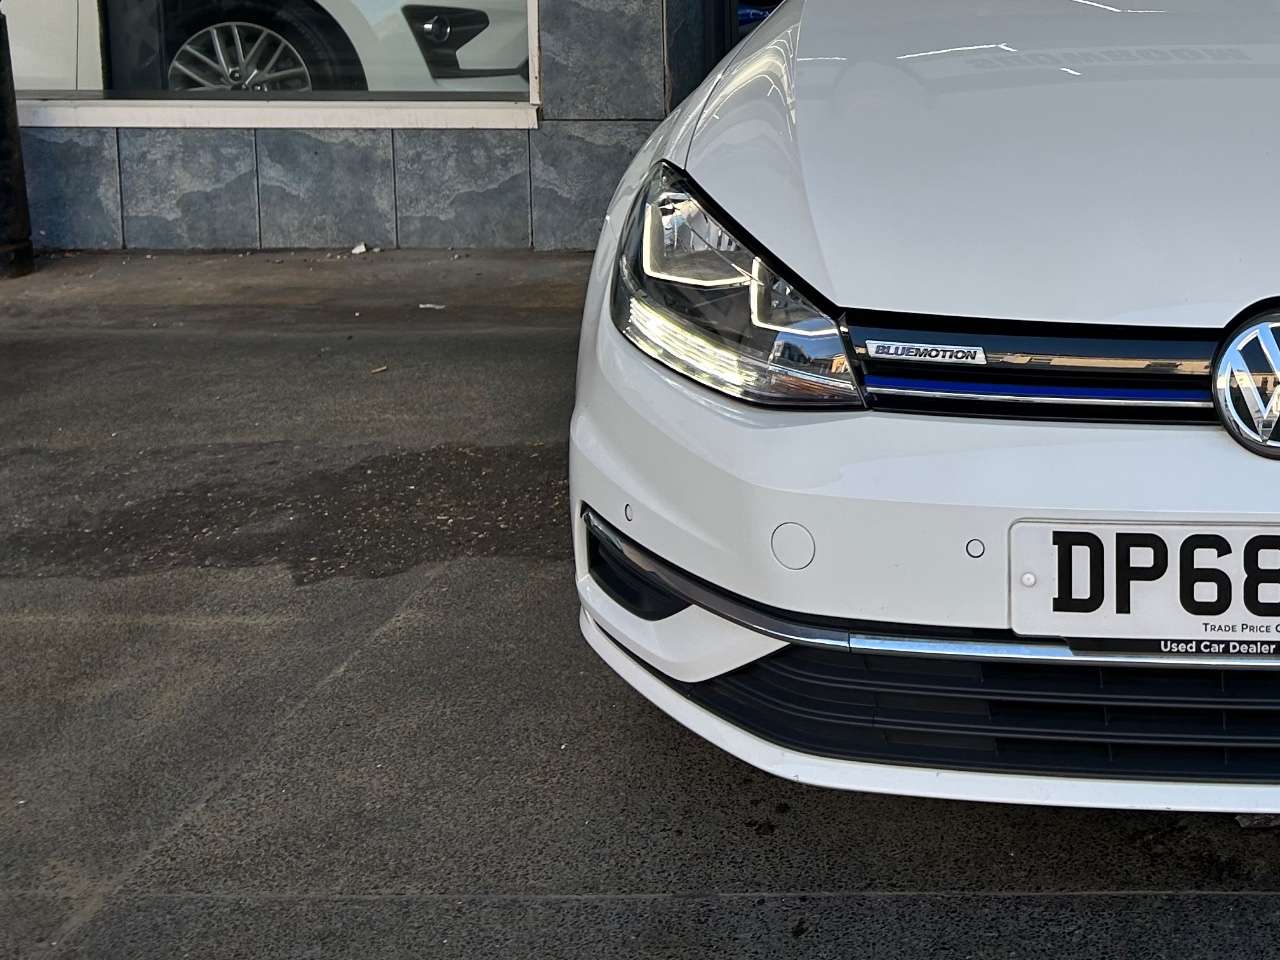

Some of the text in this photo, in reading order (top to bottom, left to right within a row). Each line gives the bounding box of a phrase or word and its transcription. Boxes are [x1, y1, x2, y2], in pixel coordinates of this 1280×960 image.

[874, 344, 978, 360] BLUEMOTION
[1160, 640, 1196, 653] Used
[1200, 641, 1224, 653] Car
[1229, 641, 1276, 654] Dealer
